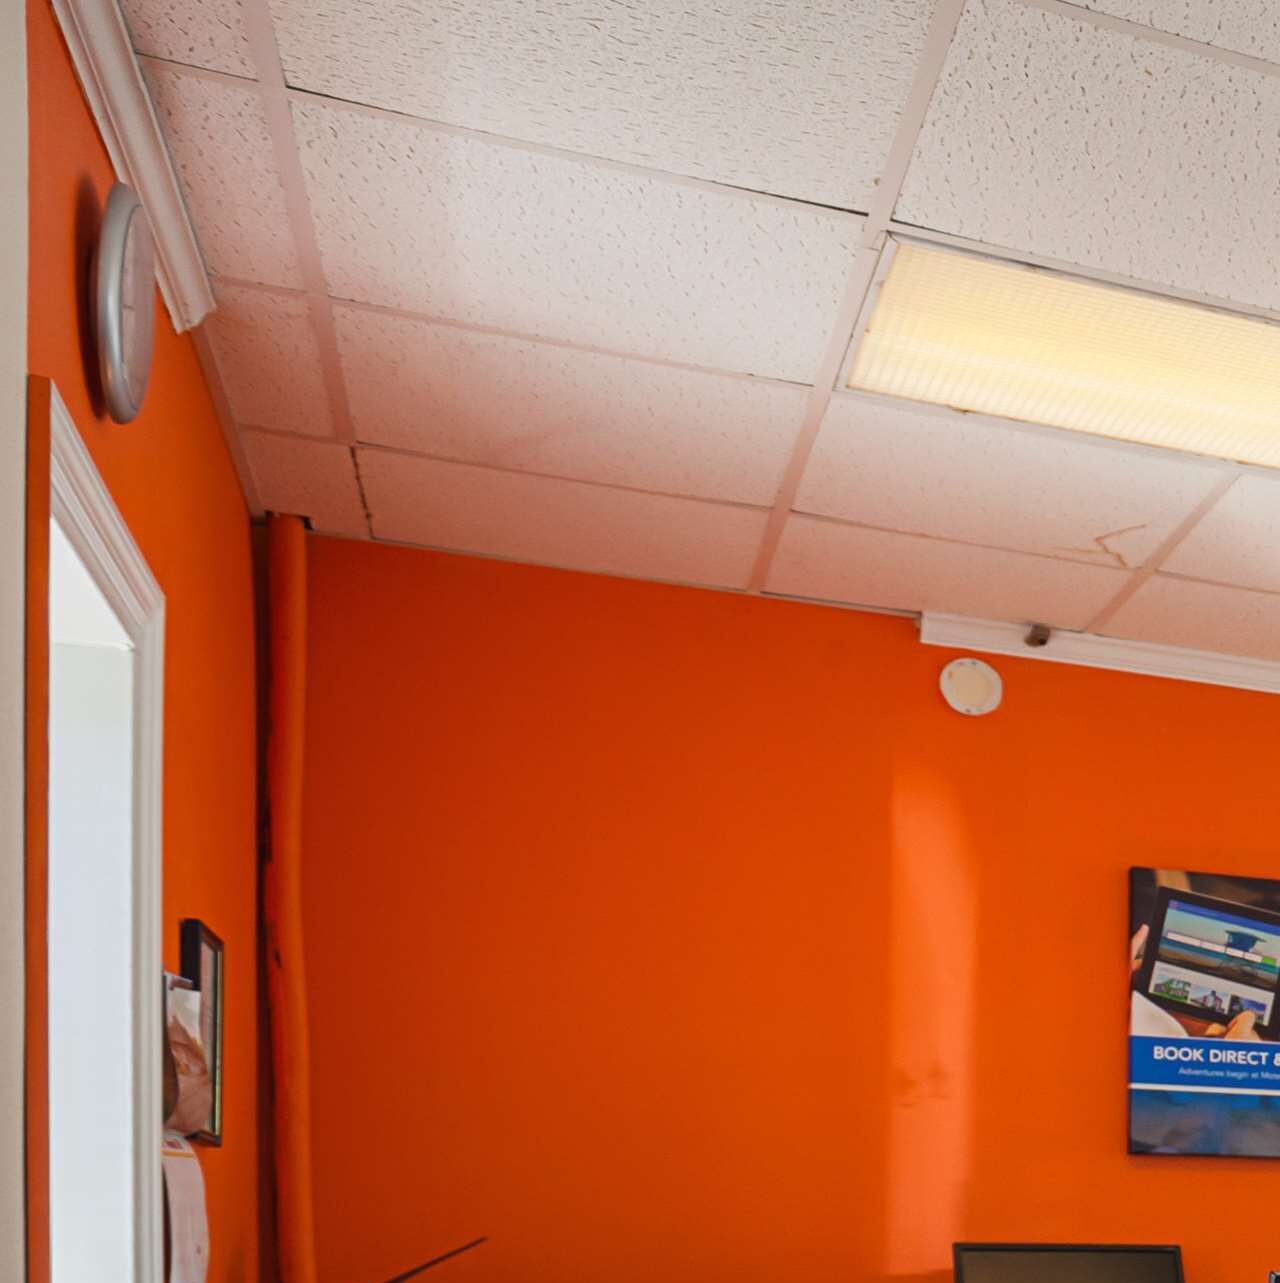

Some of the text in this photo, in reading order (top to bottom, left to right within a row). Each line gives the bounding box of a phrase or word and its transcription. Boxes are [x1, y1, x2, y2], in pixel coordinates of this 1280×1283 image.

[1153, 1046, 1204, 1062] BOOK
[1209, 1048, 1269, 1066] DIRECT
[1178, 1067, 1225, 1078] Adventures
[1226, 1070, 1249, 1080] begin
